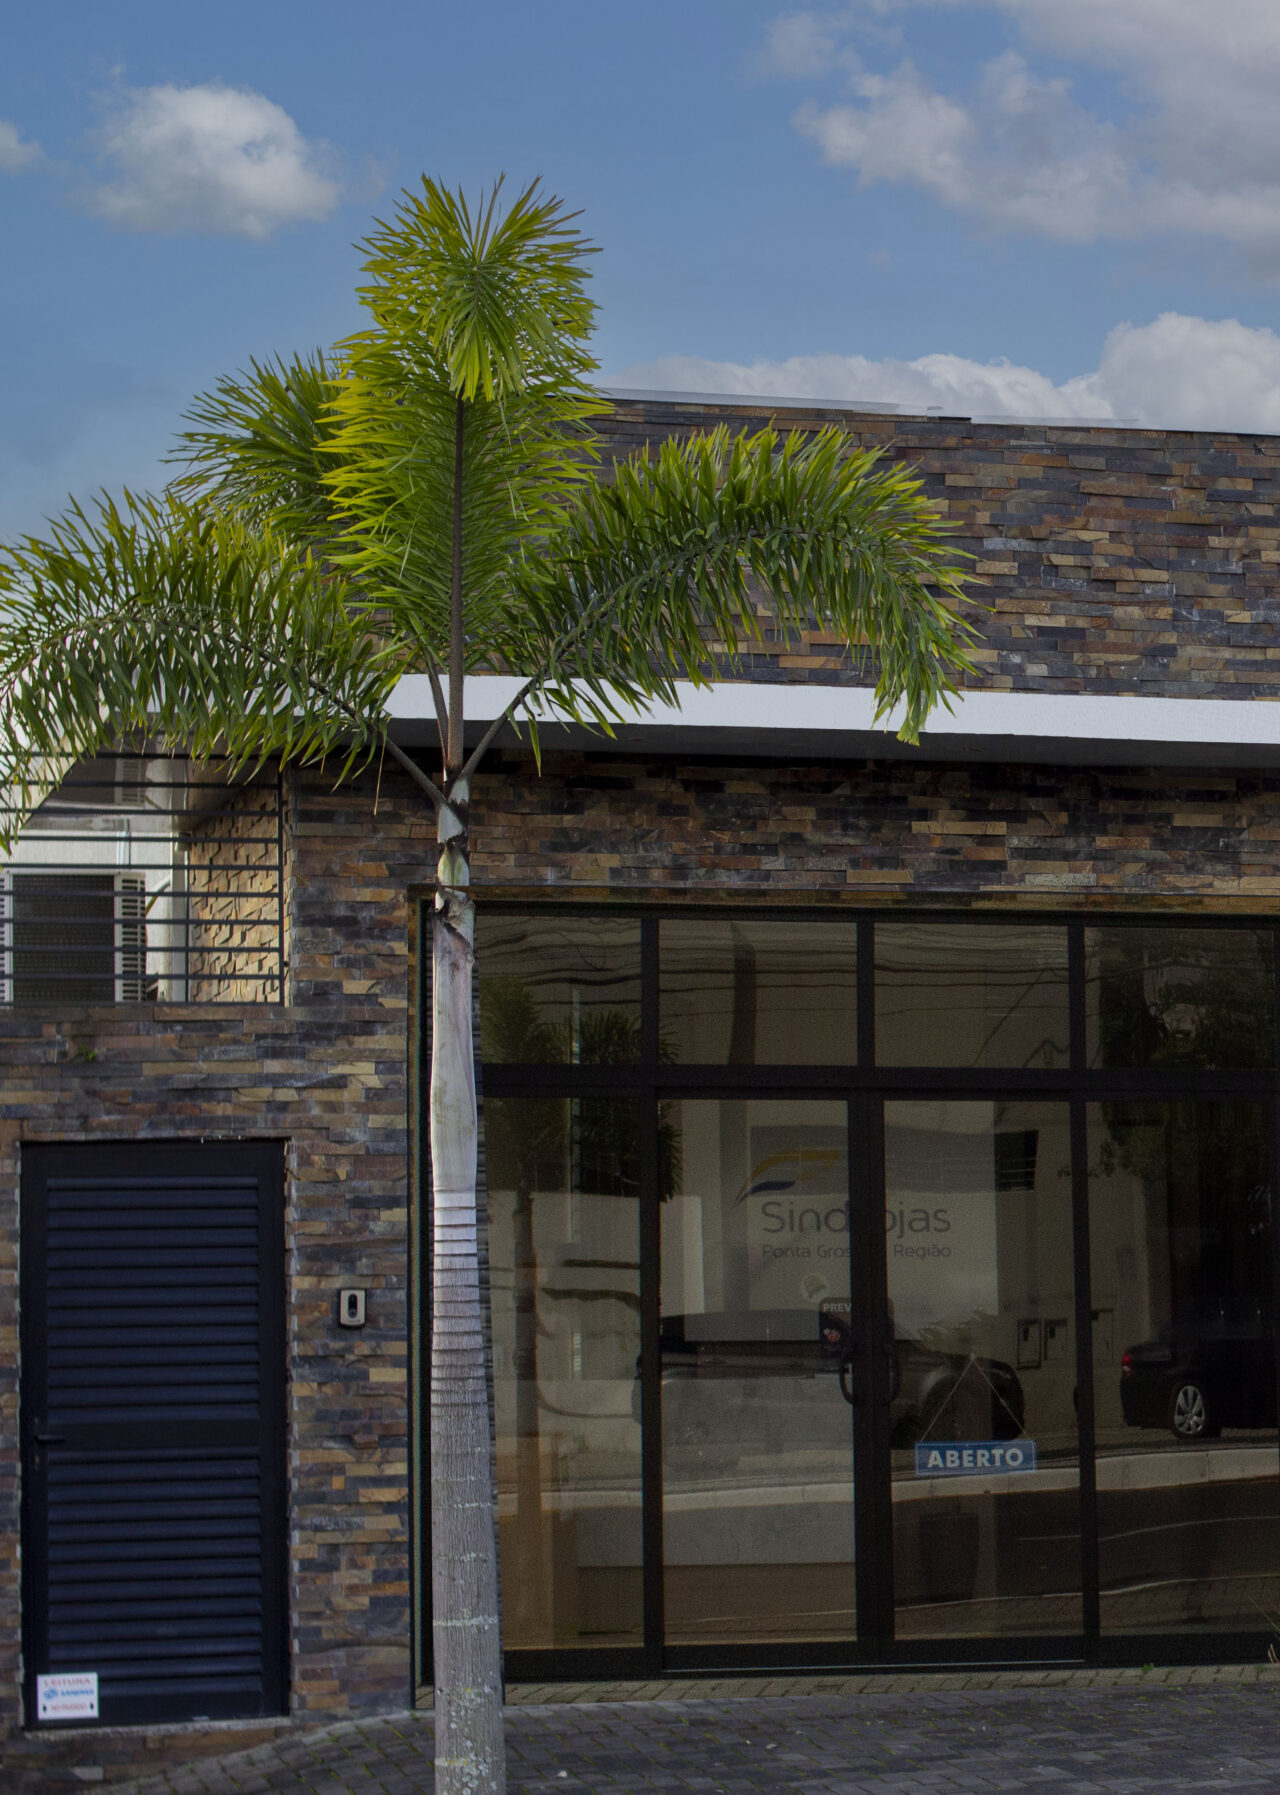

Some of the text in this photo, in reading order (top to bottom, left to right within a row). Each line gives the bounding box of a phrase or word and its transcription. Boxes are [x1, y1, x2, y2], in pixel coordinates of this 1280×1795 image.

[761, 1199, 951, 1239] Sindojas
[762, 1244, 811, 1259] Ponta
[893, 1243, 952, 1261] Região
[927, 1448, 1024, 1468] ABERTO
